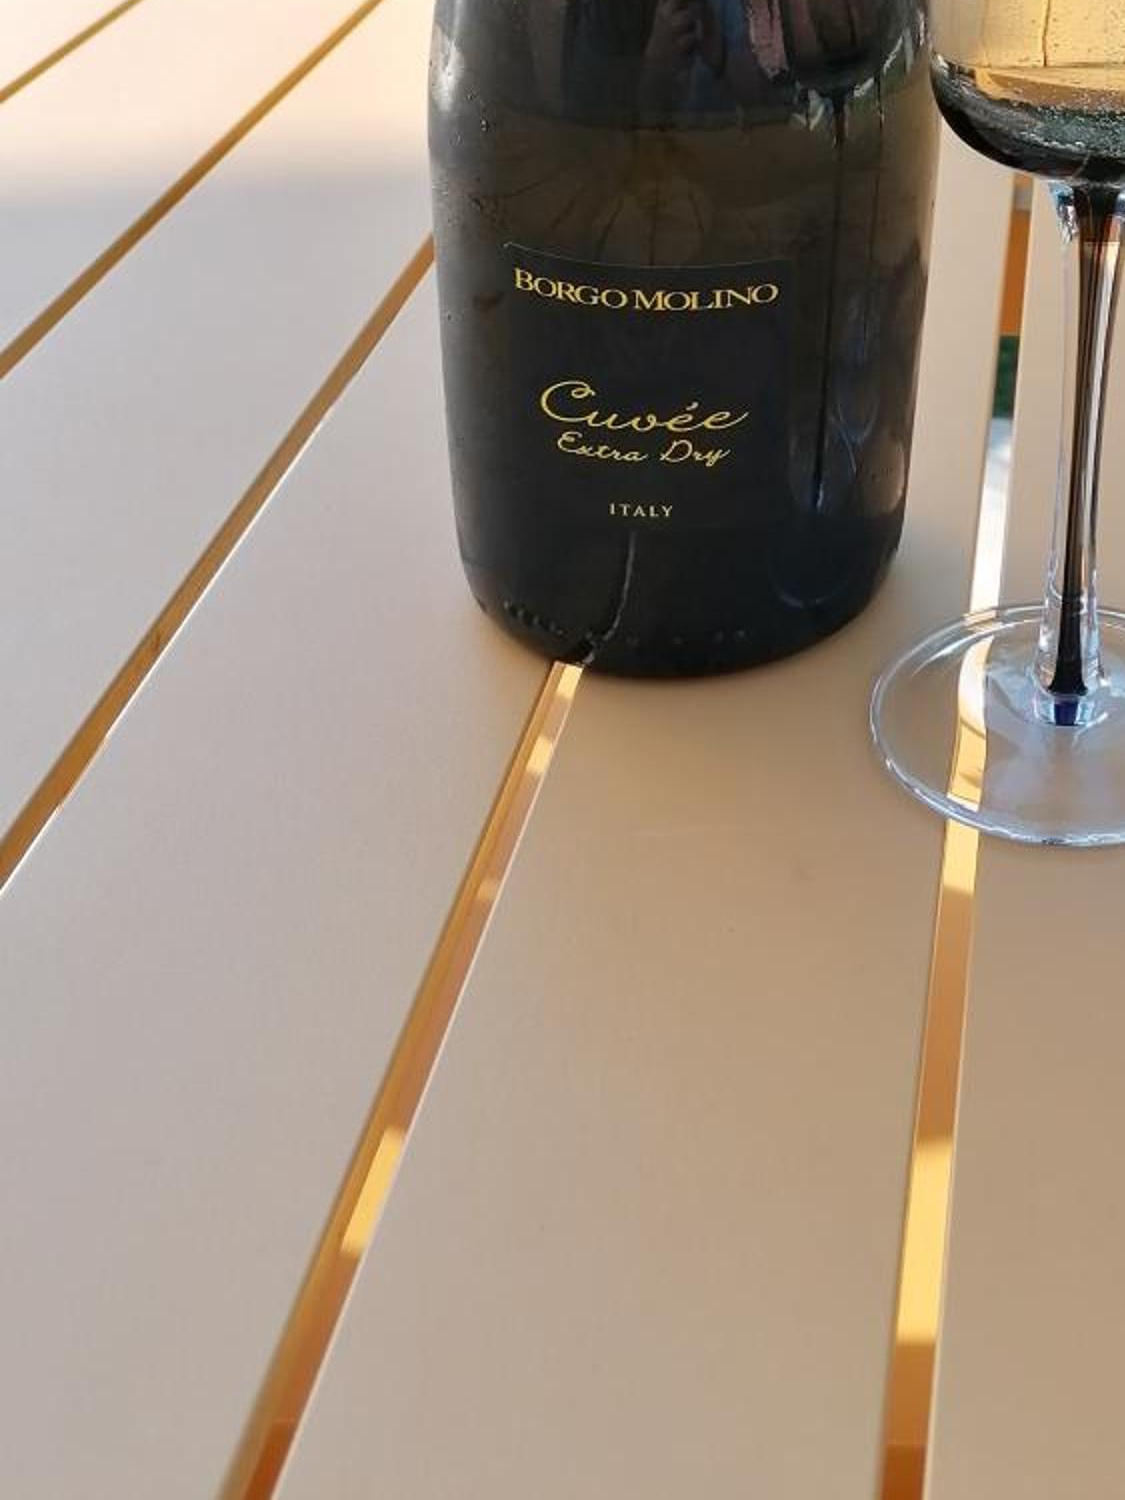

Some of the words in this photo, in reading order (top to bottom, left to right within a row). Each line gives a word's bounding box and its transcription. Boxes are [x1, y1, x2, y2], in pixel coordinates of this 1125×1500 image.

[514, 267, 628, 309] BORGO
[633, 283, 779, 311] MOLINO
[540, 380, 750, 432] Cuvée
[557, 431, 649, 461] Extra
[659, 439, 731, 467] Dry
[608, 503, 673, 518] ITALY
